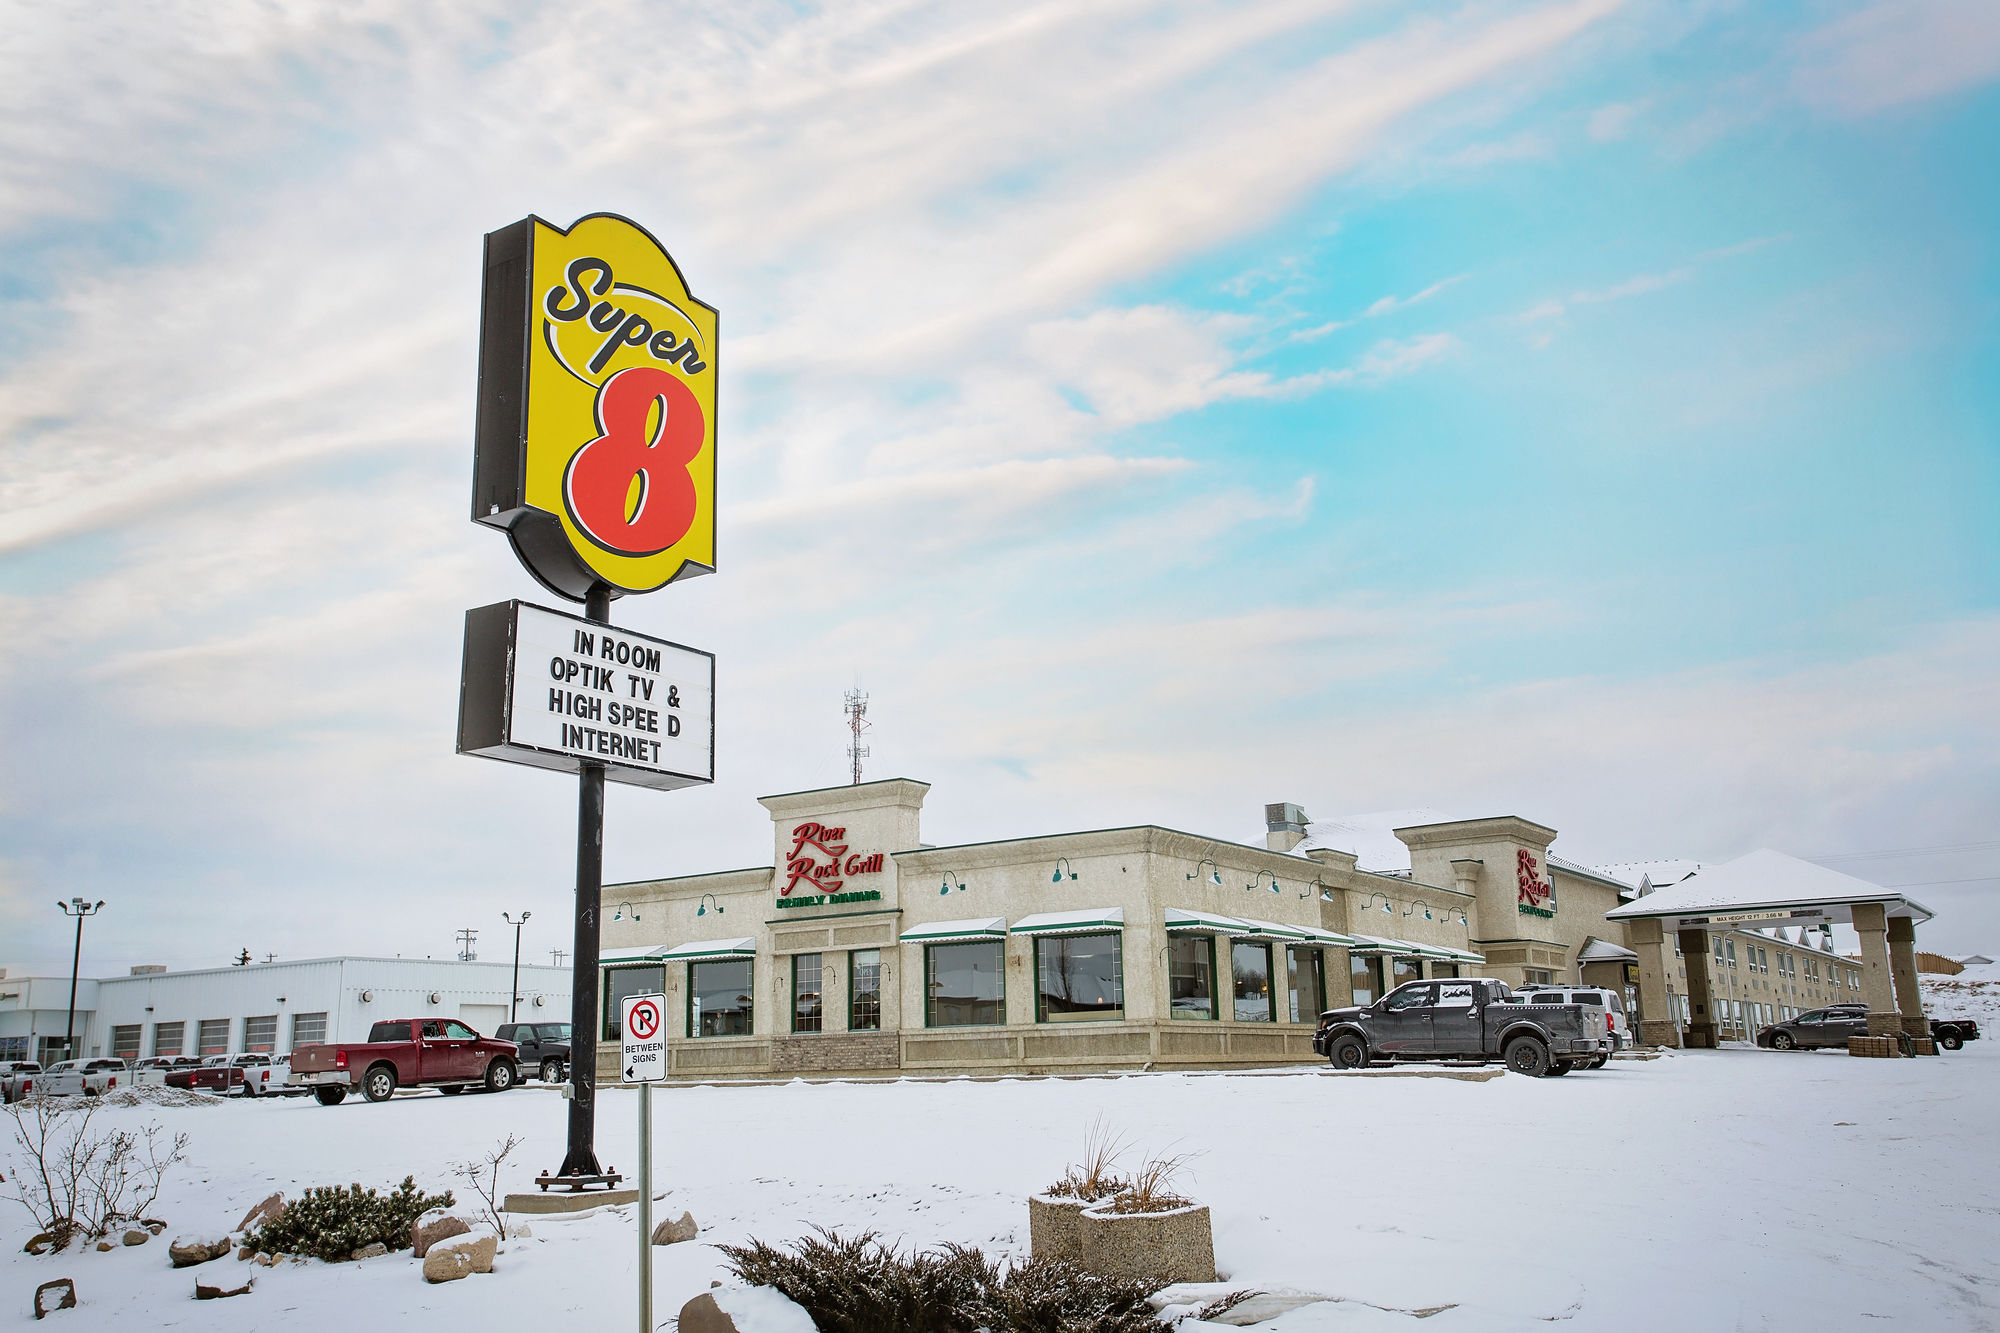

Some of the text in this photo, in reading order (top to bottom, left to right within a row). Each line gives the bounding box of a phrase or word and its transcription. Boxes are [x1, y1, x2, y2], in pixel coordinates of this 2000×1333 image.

[544, 257, 706, 375] Super
[562, 367, 705, 557] 8
[573, 629, 661, 673] IN ROOM
[550, 656, 680, 708] OPTIK TV &
[548, 688, 602, 721] HIGH
[562, 723, 662, 763] INTERNET
[786, 822, 848, 860] River
[780, 853, 884, 896] Rock Grill
[829, 890, 880, 904] DINING
[626, 1042, 663, 1054] BETWEEN
[632, 1054, 656, 1064] SIGNS
